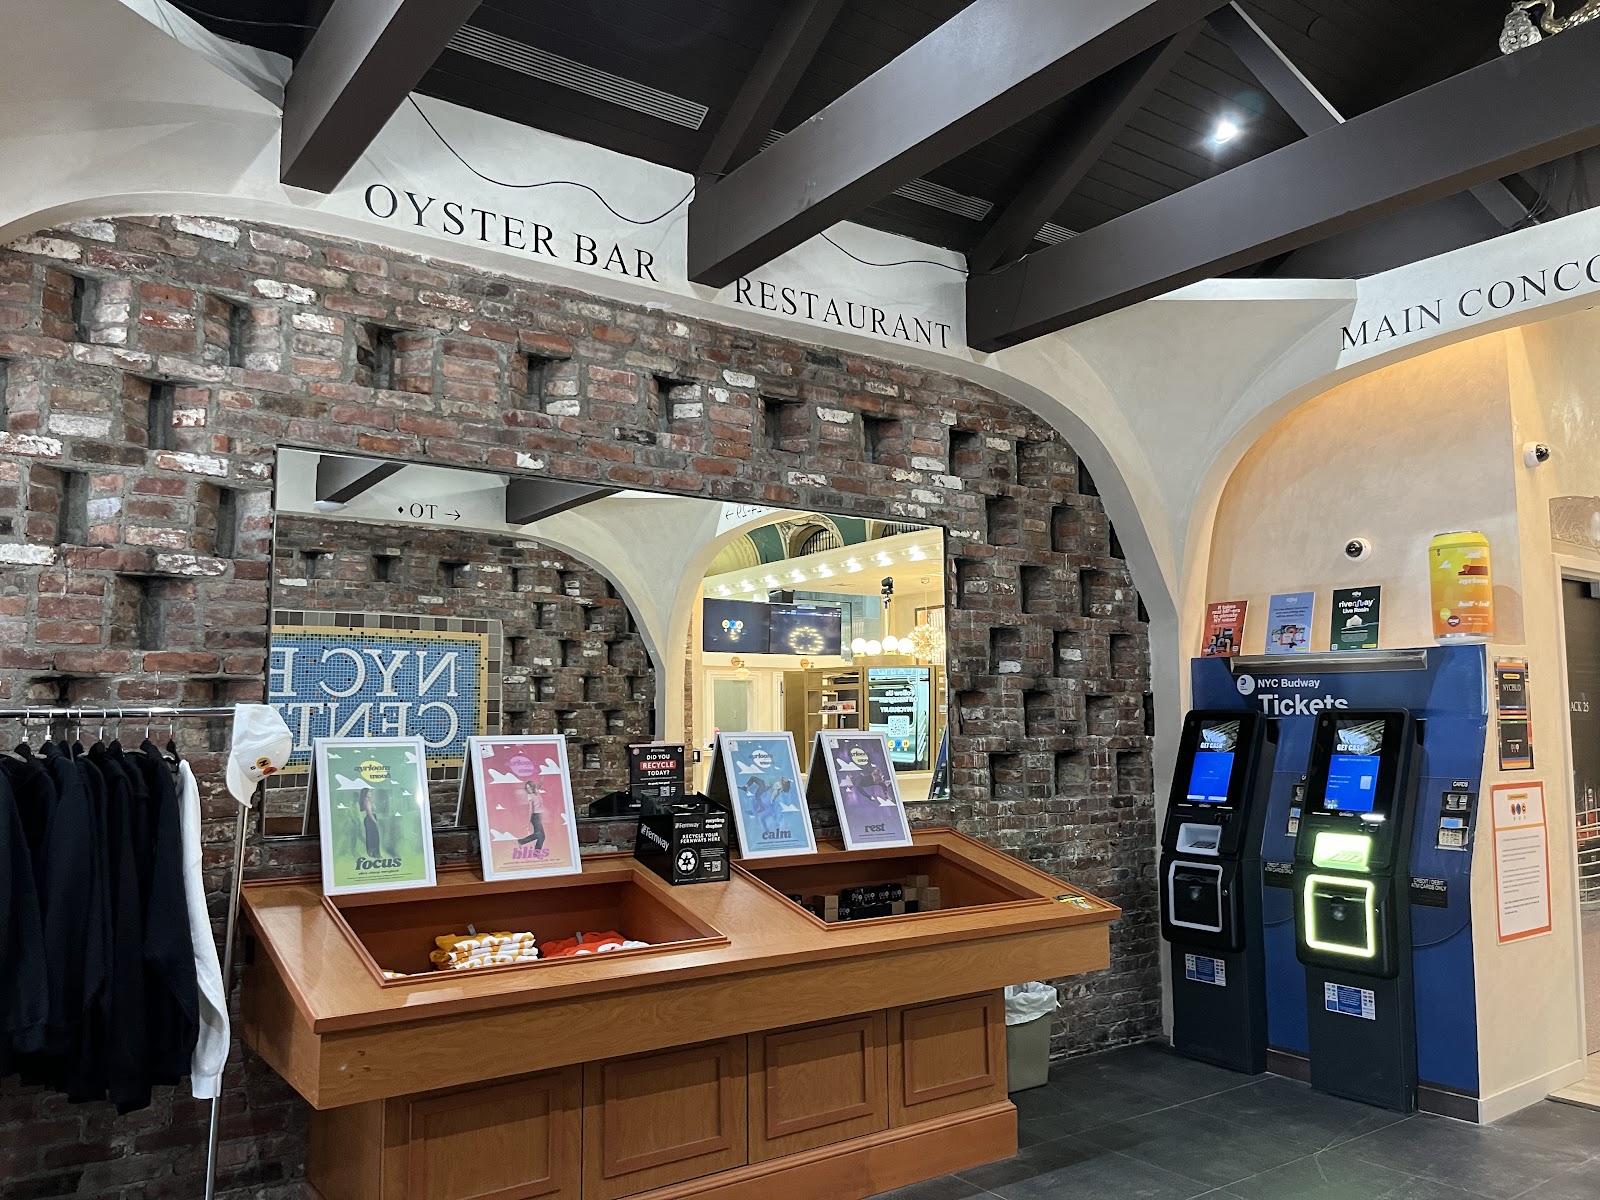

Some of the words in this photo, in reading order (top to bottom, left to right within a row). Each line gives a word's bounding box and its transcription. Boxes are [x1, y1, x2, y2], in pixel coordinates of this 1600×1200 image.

[364, 183, 560, 258] OYSTER
[573, 231, 659, 282] BAR
[734, 276, 951, 349] RESTAURANT
[1339, 298, 1442, 351] MAIN
[1257, 678, 1279, 688] NYC
[1281, 678, 1320, 689] Budway
[1257, 693, 1349, 716] Tickets
[1570, 701, 1582, 712] ACK
[1336, 743, 1348, 751] GET
[642, 761, 674, 769] RECYCLE
[864, 823, 885, 832] rest
[762, 829, 791, 840] calm
[511, 846, 550, 860] bliss
[355, 857, 402, 871] focus
